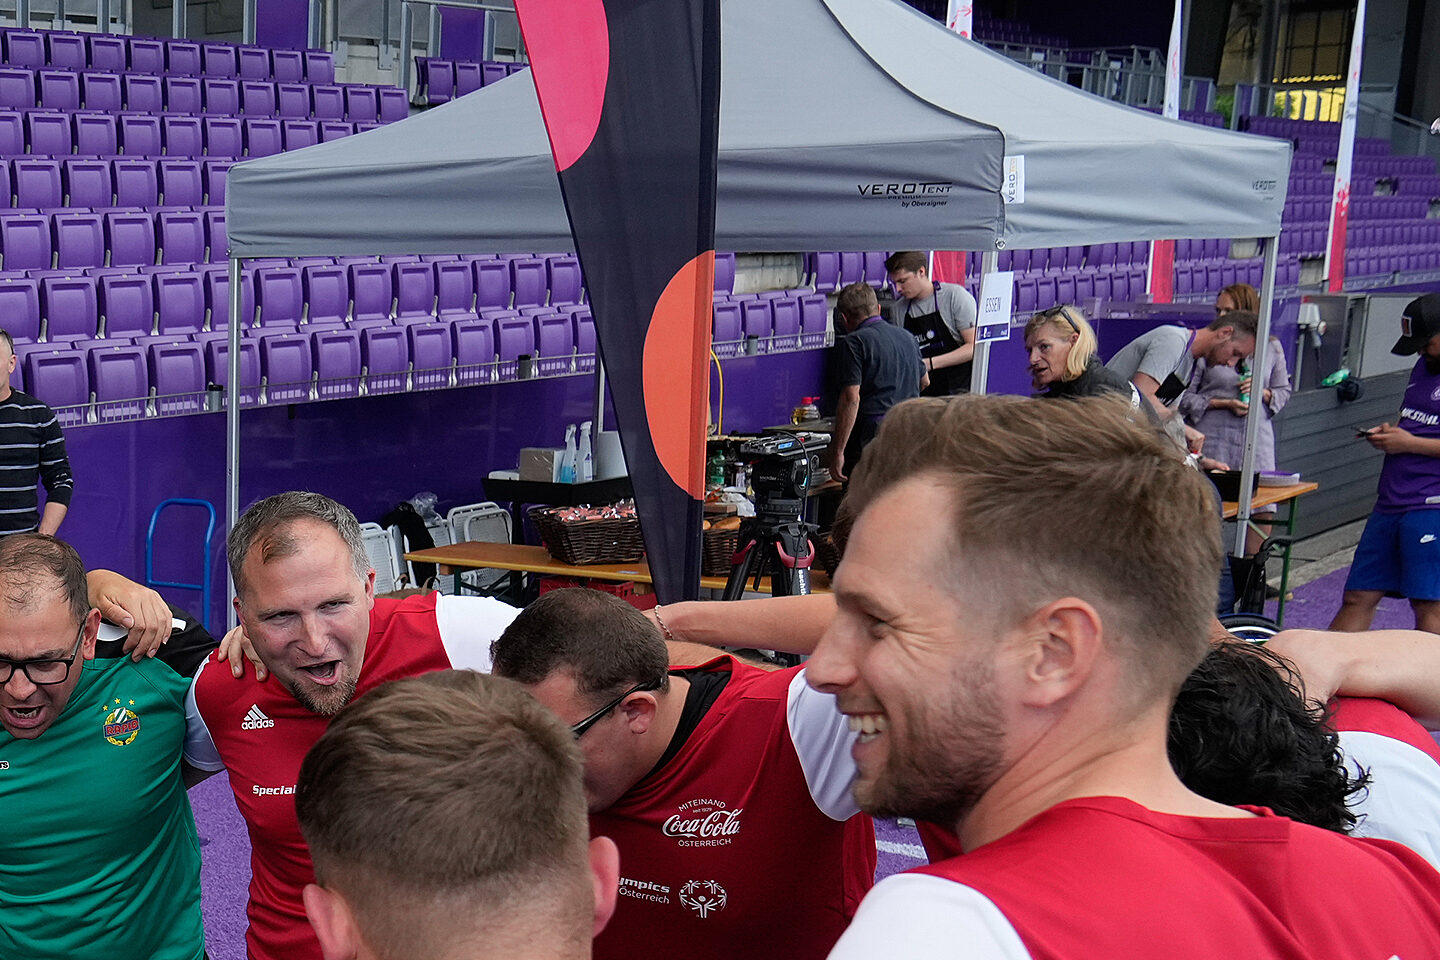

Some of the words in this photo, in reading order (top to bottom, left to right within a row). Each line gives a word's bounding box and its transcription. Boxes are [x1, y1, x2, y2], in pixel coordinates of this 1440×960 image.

[901, 200, 909, 208] by
[911, 200, 948, 208] Oberaigner
[105, 719, 139, 736] RAPID
[241, 719, 275, 730] adidas
[252, 785, 297, 797] Special
[678, 798, 726, 812] MITEINAND
[662, 809, 744, 838] Coca-Cola
[678, 838, 732, 848] ÖSTERREICH
[618, 886, 670, 905] Österreich
